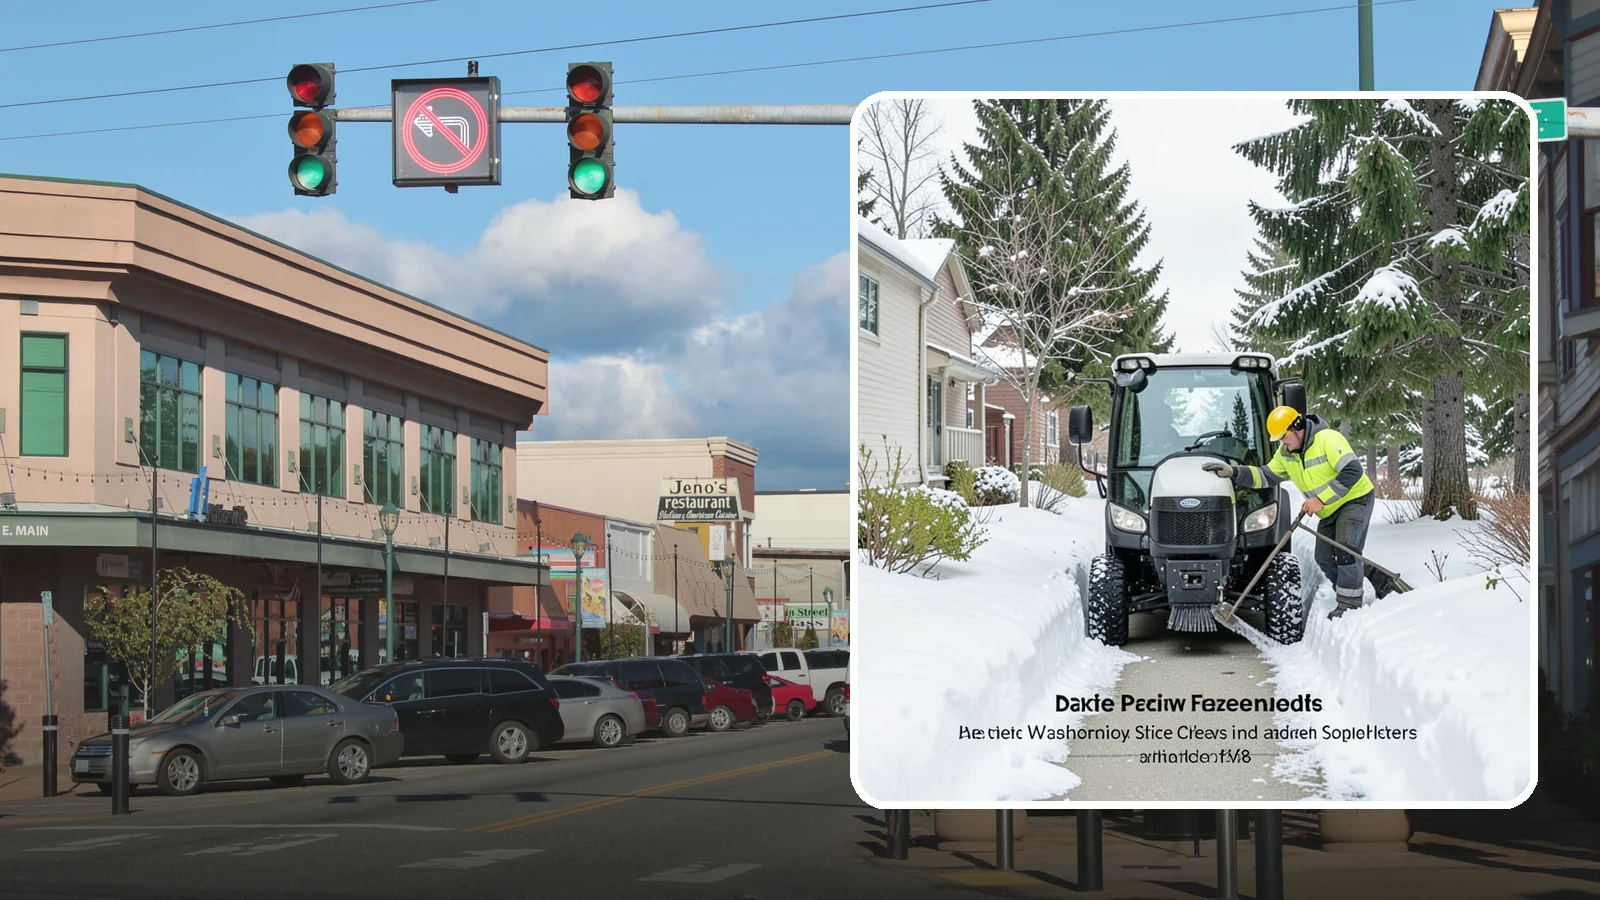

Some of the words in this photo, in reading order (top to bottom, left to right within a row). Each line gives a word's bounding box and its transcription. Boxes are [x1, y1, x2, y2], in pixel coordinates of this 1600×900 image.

[669, 480, 728, 495] Jeno's
[665, 496, 731, 509] restaurant
[658, 510, 681, 520] Italian
[685, 510, 715, 519] American
[714, 509, 737, 519] Cuisine
[2, 525, 13, 536] E.
[15, 525, 49, 537] MAIN
[797, 607, 828, 617] Street
[789, 619, 824, 628] lass
